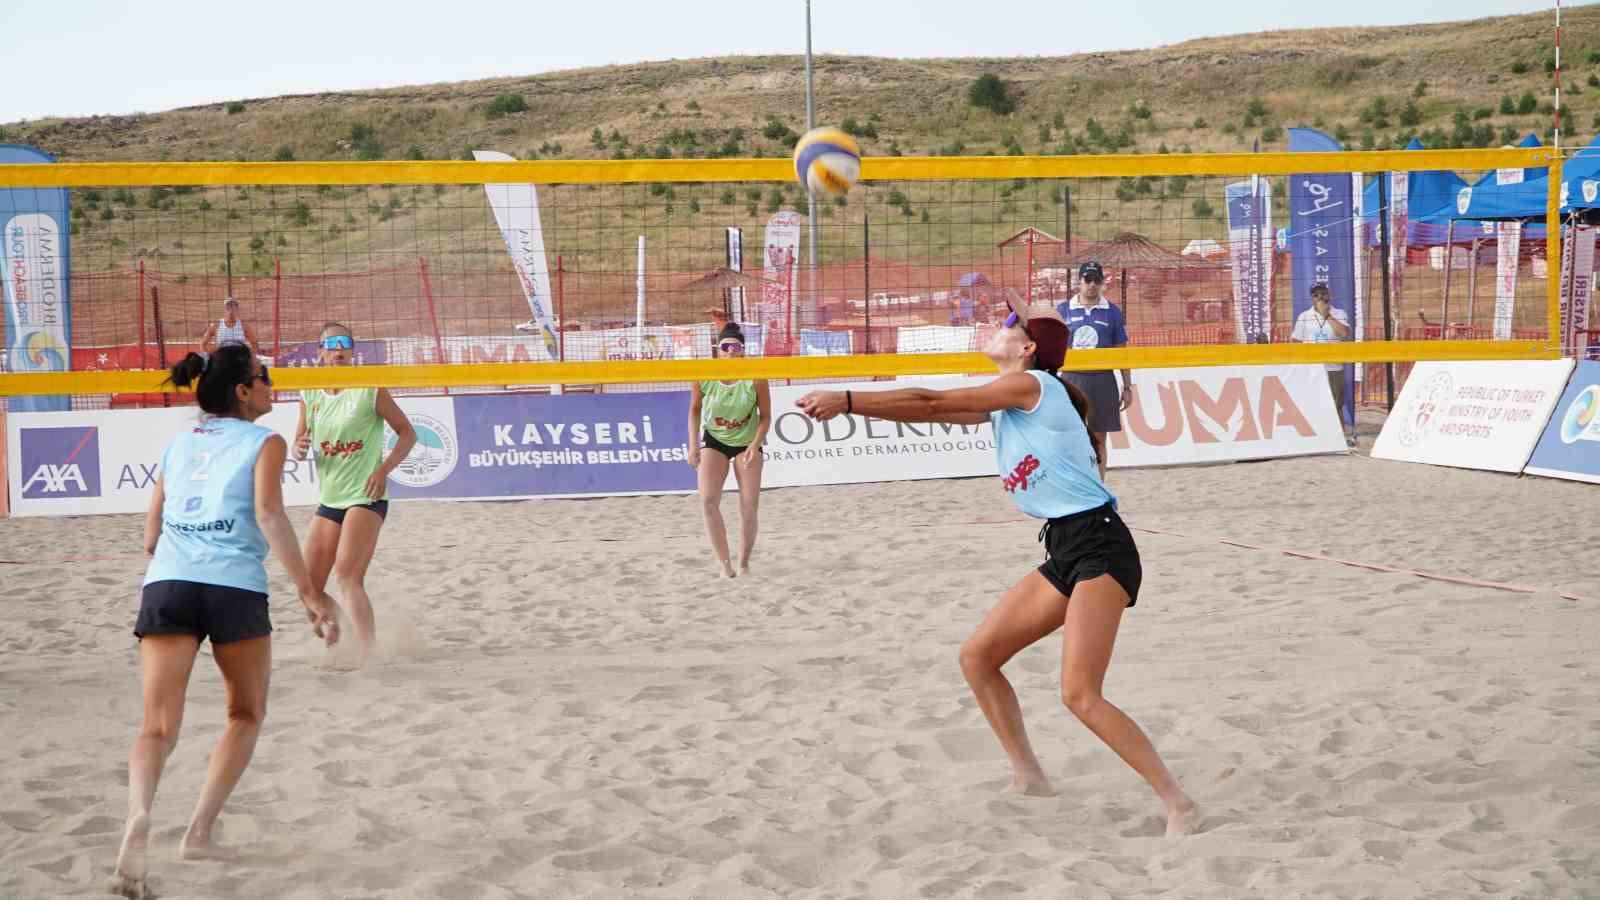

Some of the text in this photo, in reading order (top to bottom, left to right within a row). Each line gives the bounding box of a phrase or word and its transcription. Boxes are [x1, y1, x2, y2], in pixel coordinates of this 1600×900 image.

[493, 416, 653, 447] KAYSERİ
[469, 443, 689, 468] BÜYÜKŞEHİR BELEDİYESİ
[762, 447, 844, 462] ORATOIRE
[22, 463, 88, 492] AXA
[117, 464, 158, 489] AX
